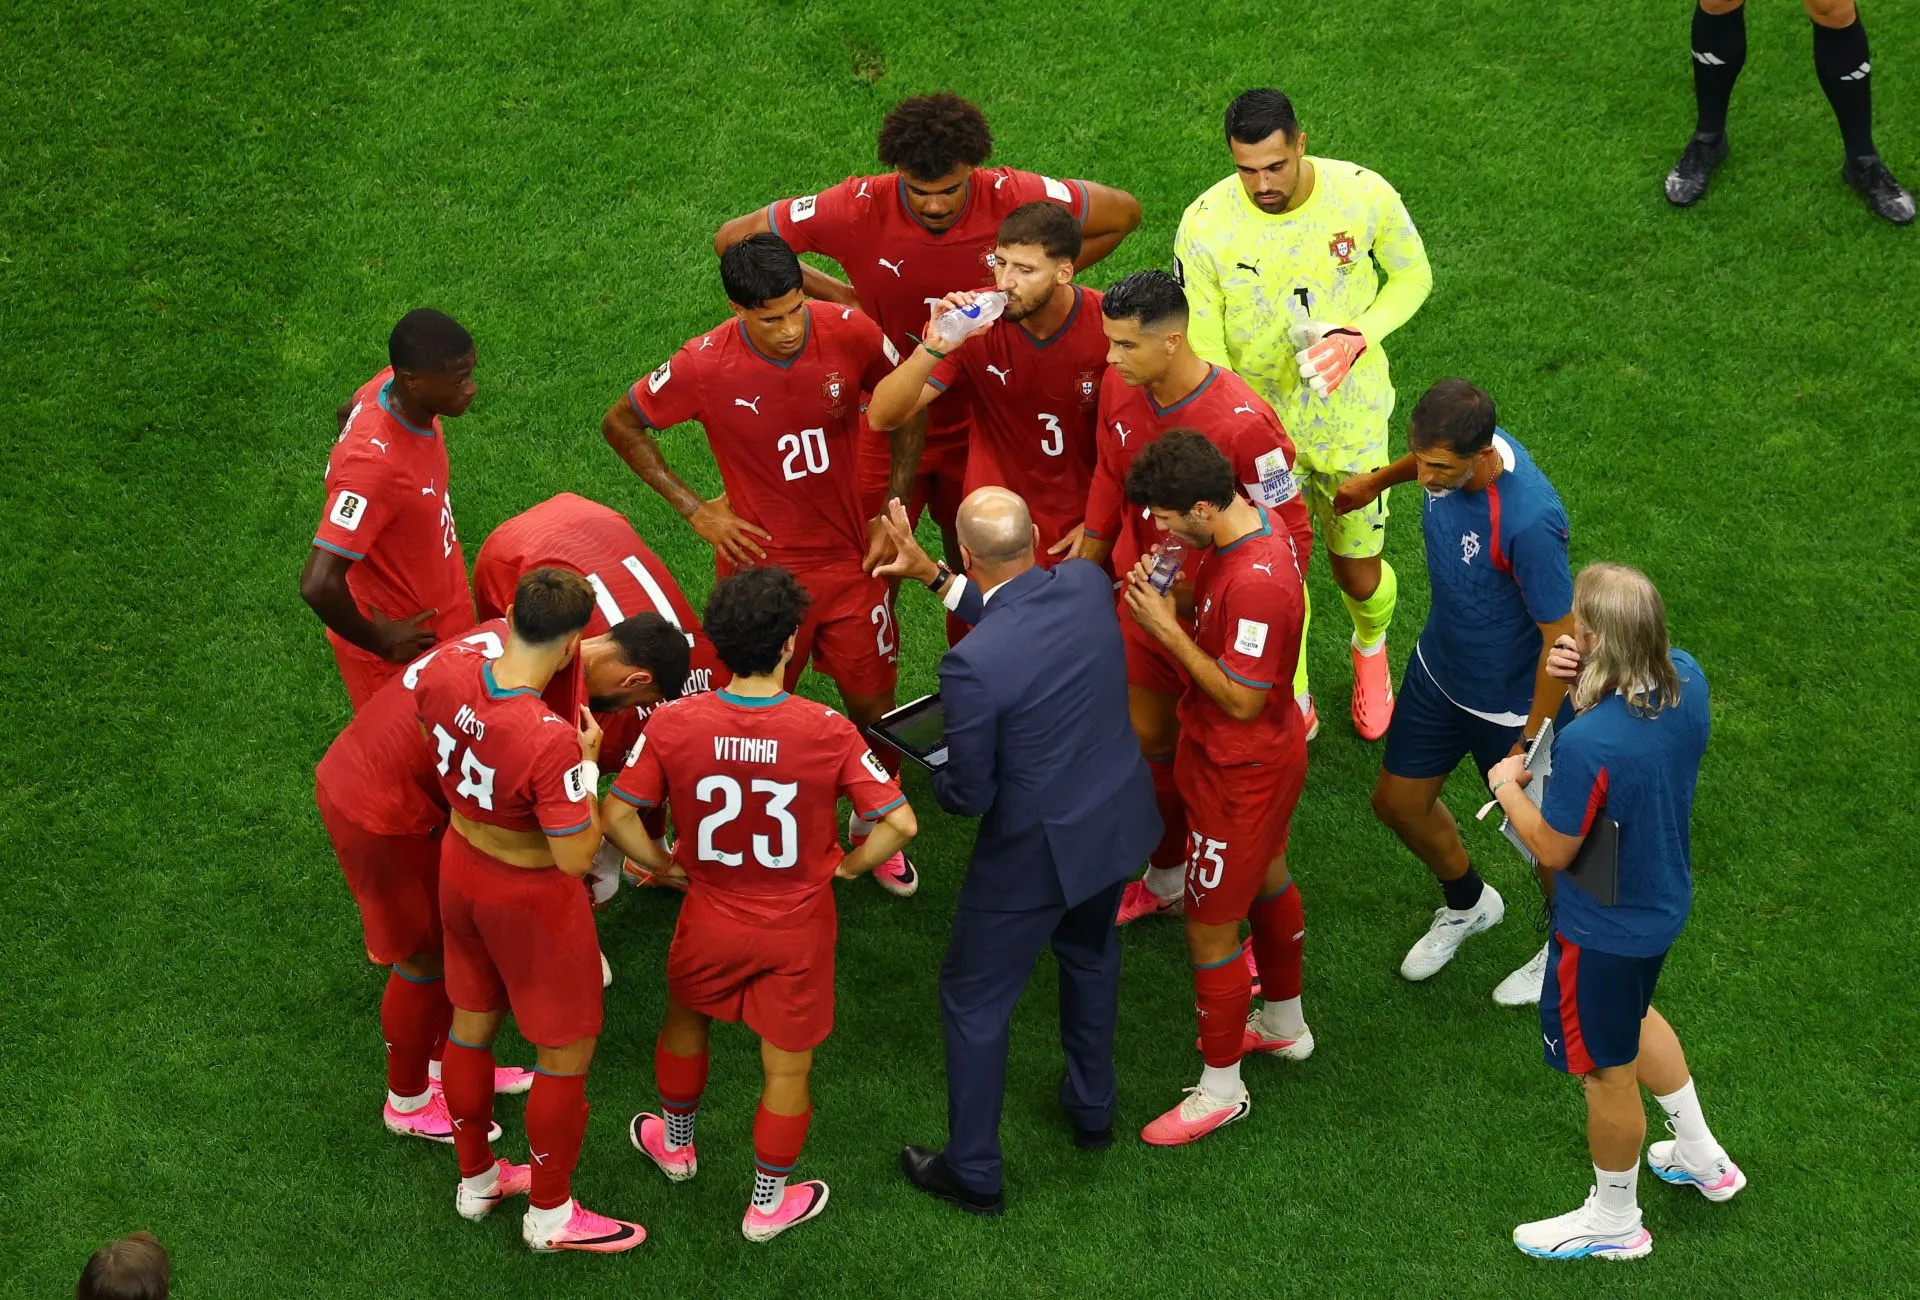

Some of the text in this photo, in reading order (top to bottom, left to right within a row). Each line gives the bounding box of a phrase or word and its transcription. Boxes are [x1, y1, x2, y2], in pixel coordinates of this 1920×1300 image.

[777, 427, 830, 482] 20
[1037, 413, 1064, 457] 3
[1263, 473, 1291, 493] UNITES
[713, 735, 778, 764] VITINHA
[695, 774, 798, 869] 23
[1188, 830, 1228, 889] 15
